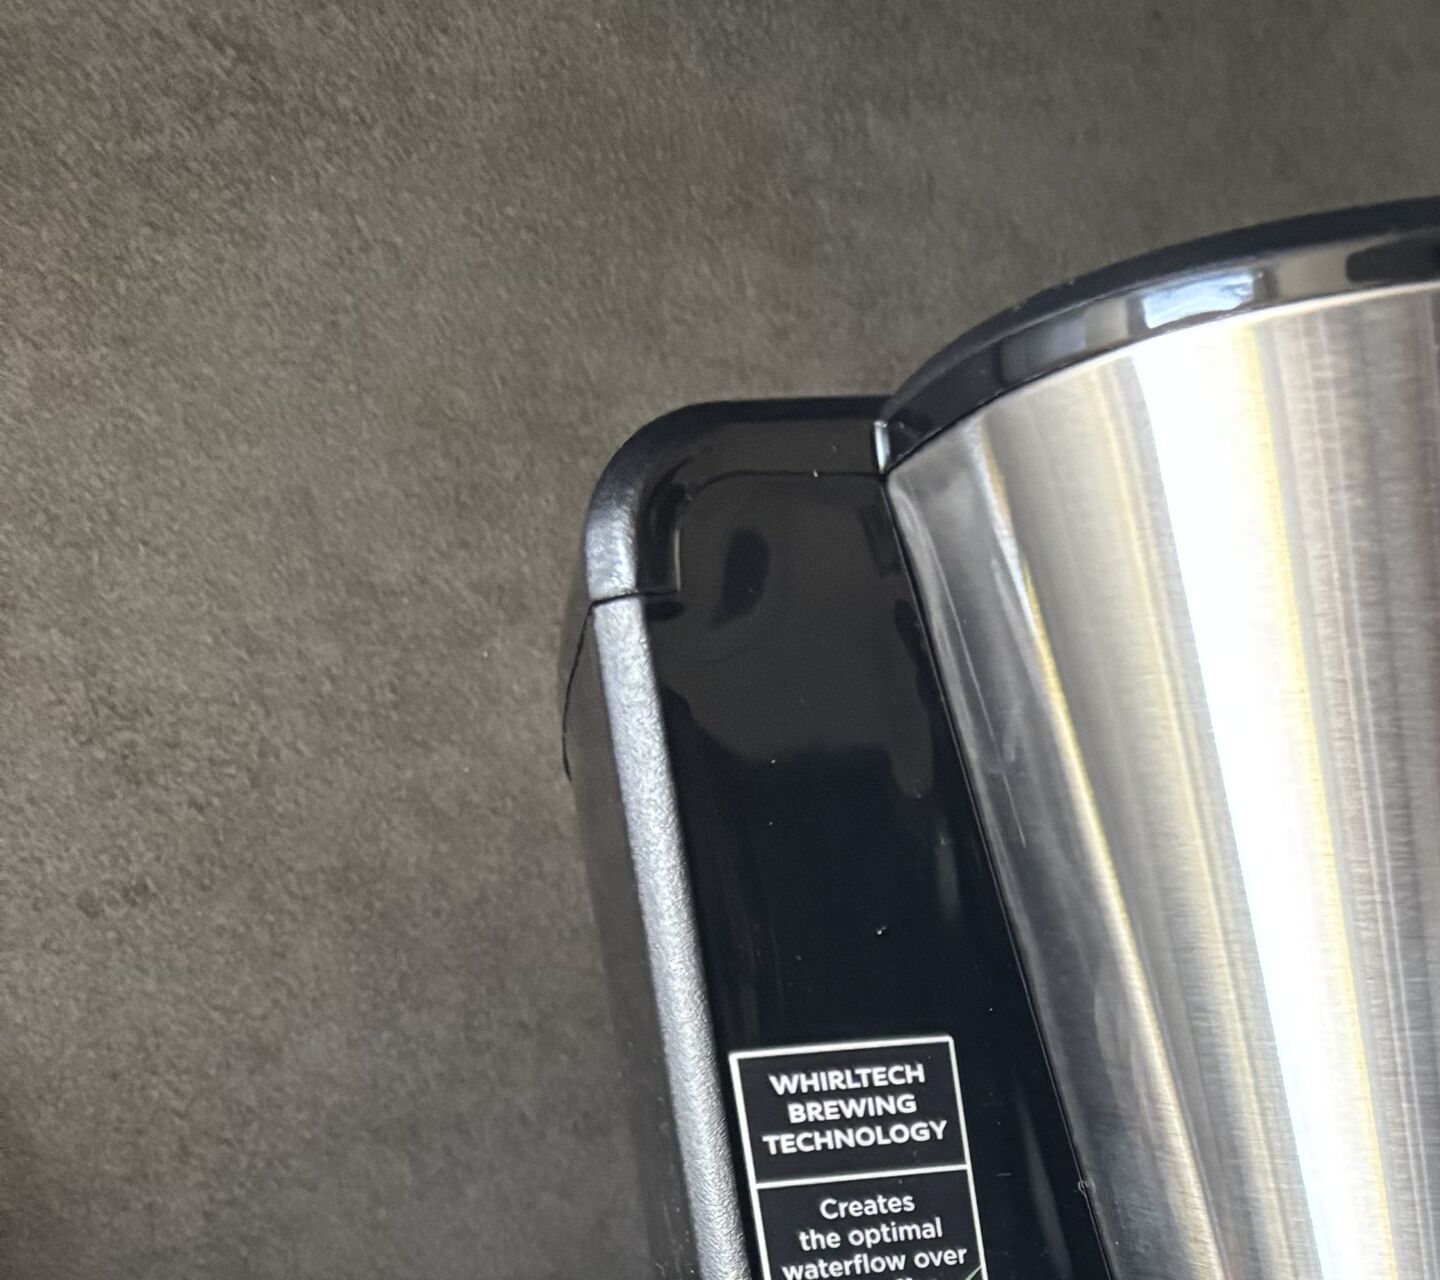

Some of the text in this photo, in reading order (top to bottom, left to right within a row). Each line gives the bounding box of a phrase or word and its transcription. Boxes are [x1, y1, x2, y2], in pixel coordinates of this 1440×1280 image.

[768, 1062, 926, 1096] WHIRLTECH
[787, 1093, 917, 1125] BREWING
[762, 1120, 948, 1156] TECHNOLOGY
[819, 1193, 915, 1220] Creates
[799, 1217, 943, 1254] the optimal
[914, 1247, 968, 1271] over
